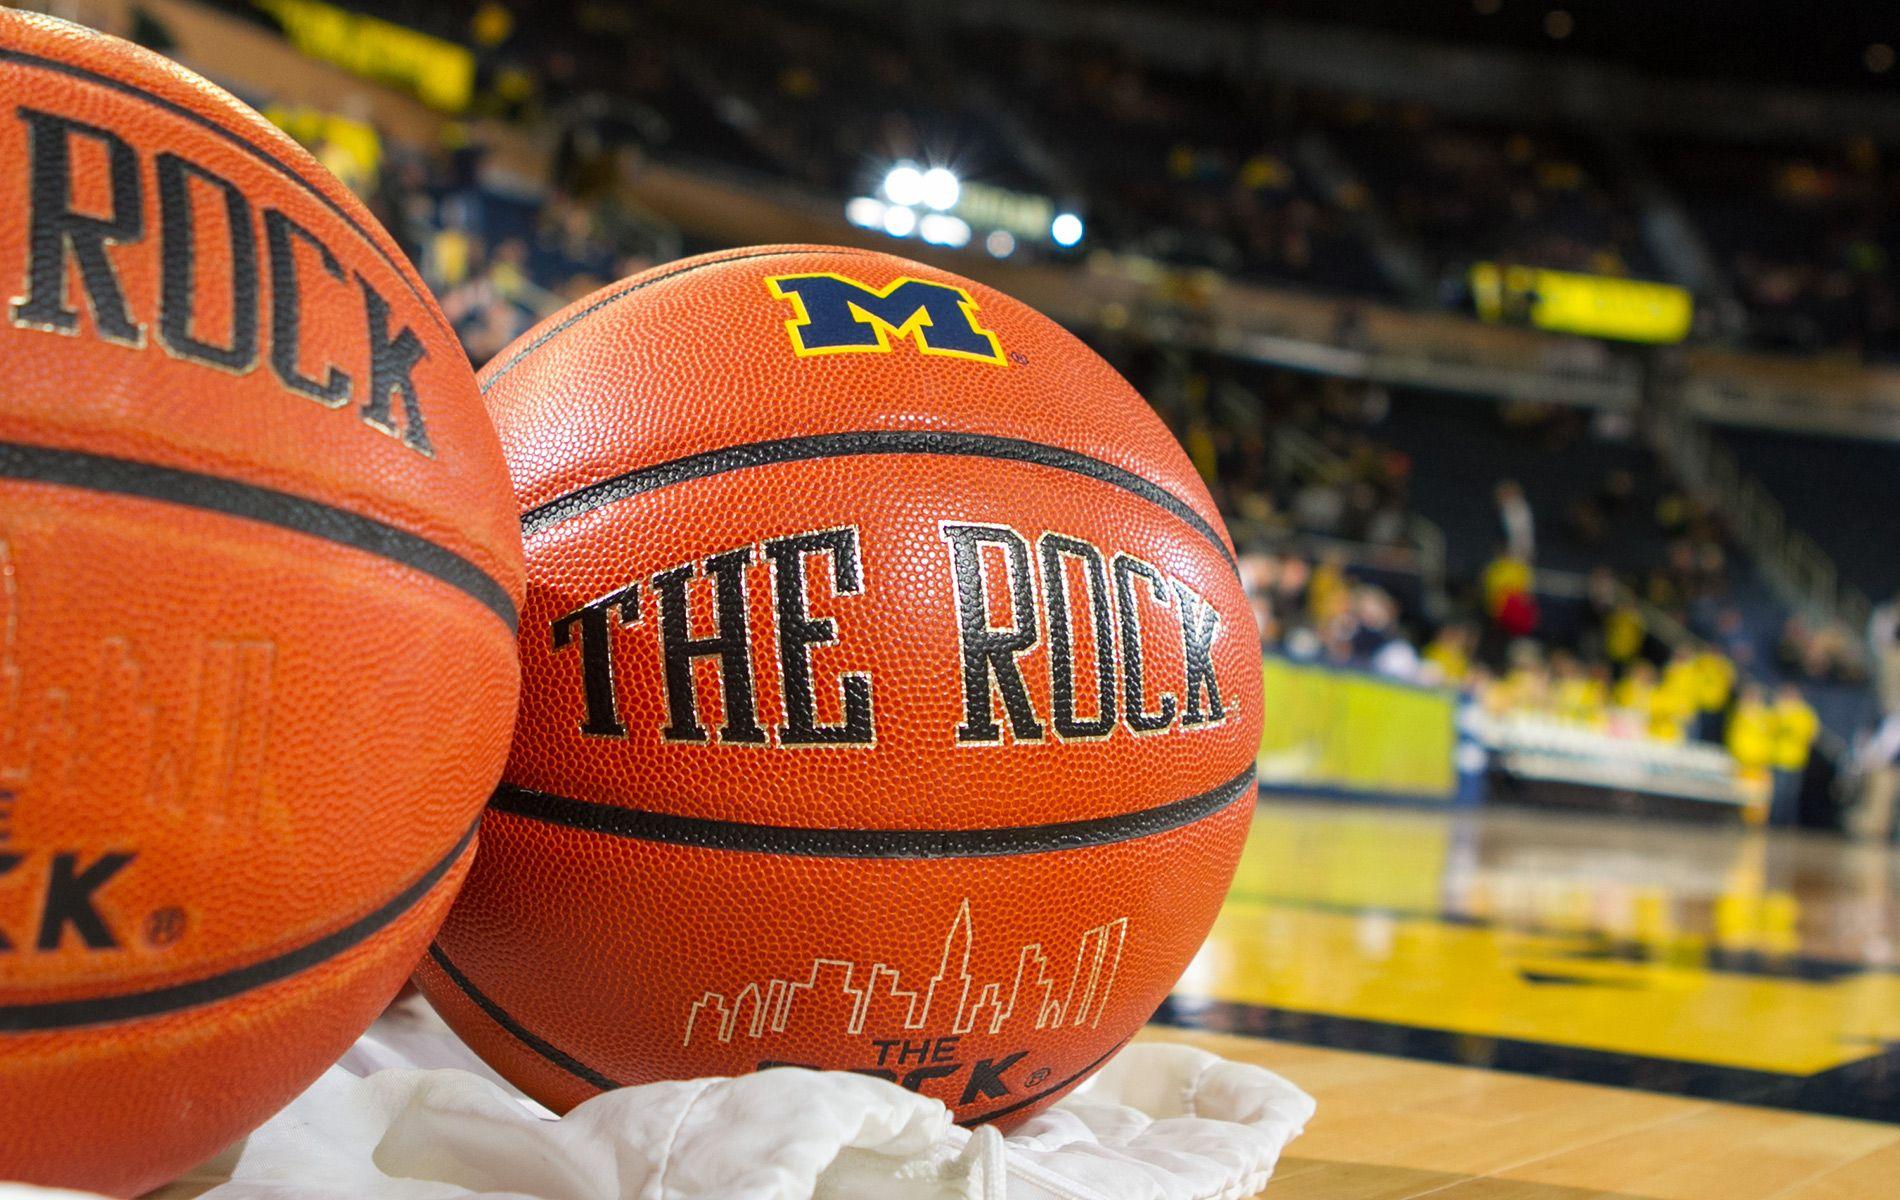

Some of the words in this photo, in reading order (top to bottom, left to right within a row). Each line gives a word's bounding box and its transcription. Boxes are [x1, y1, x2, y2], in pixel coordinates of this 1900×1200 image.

[8, 106, 436, 460] ROCK
[764, 272, 1009, 367] M
[549, 523, 876, 750] THE
[938, 519, 1228, 748] ROCK
[872, 1037, 959, 1066] THE
